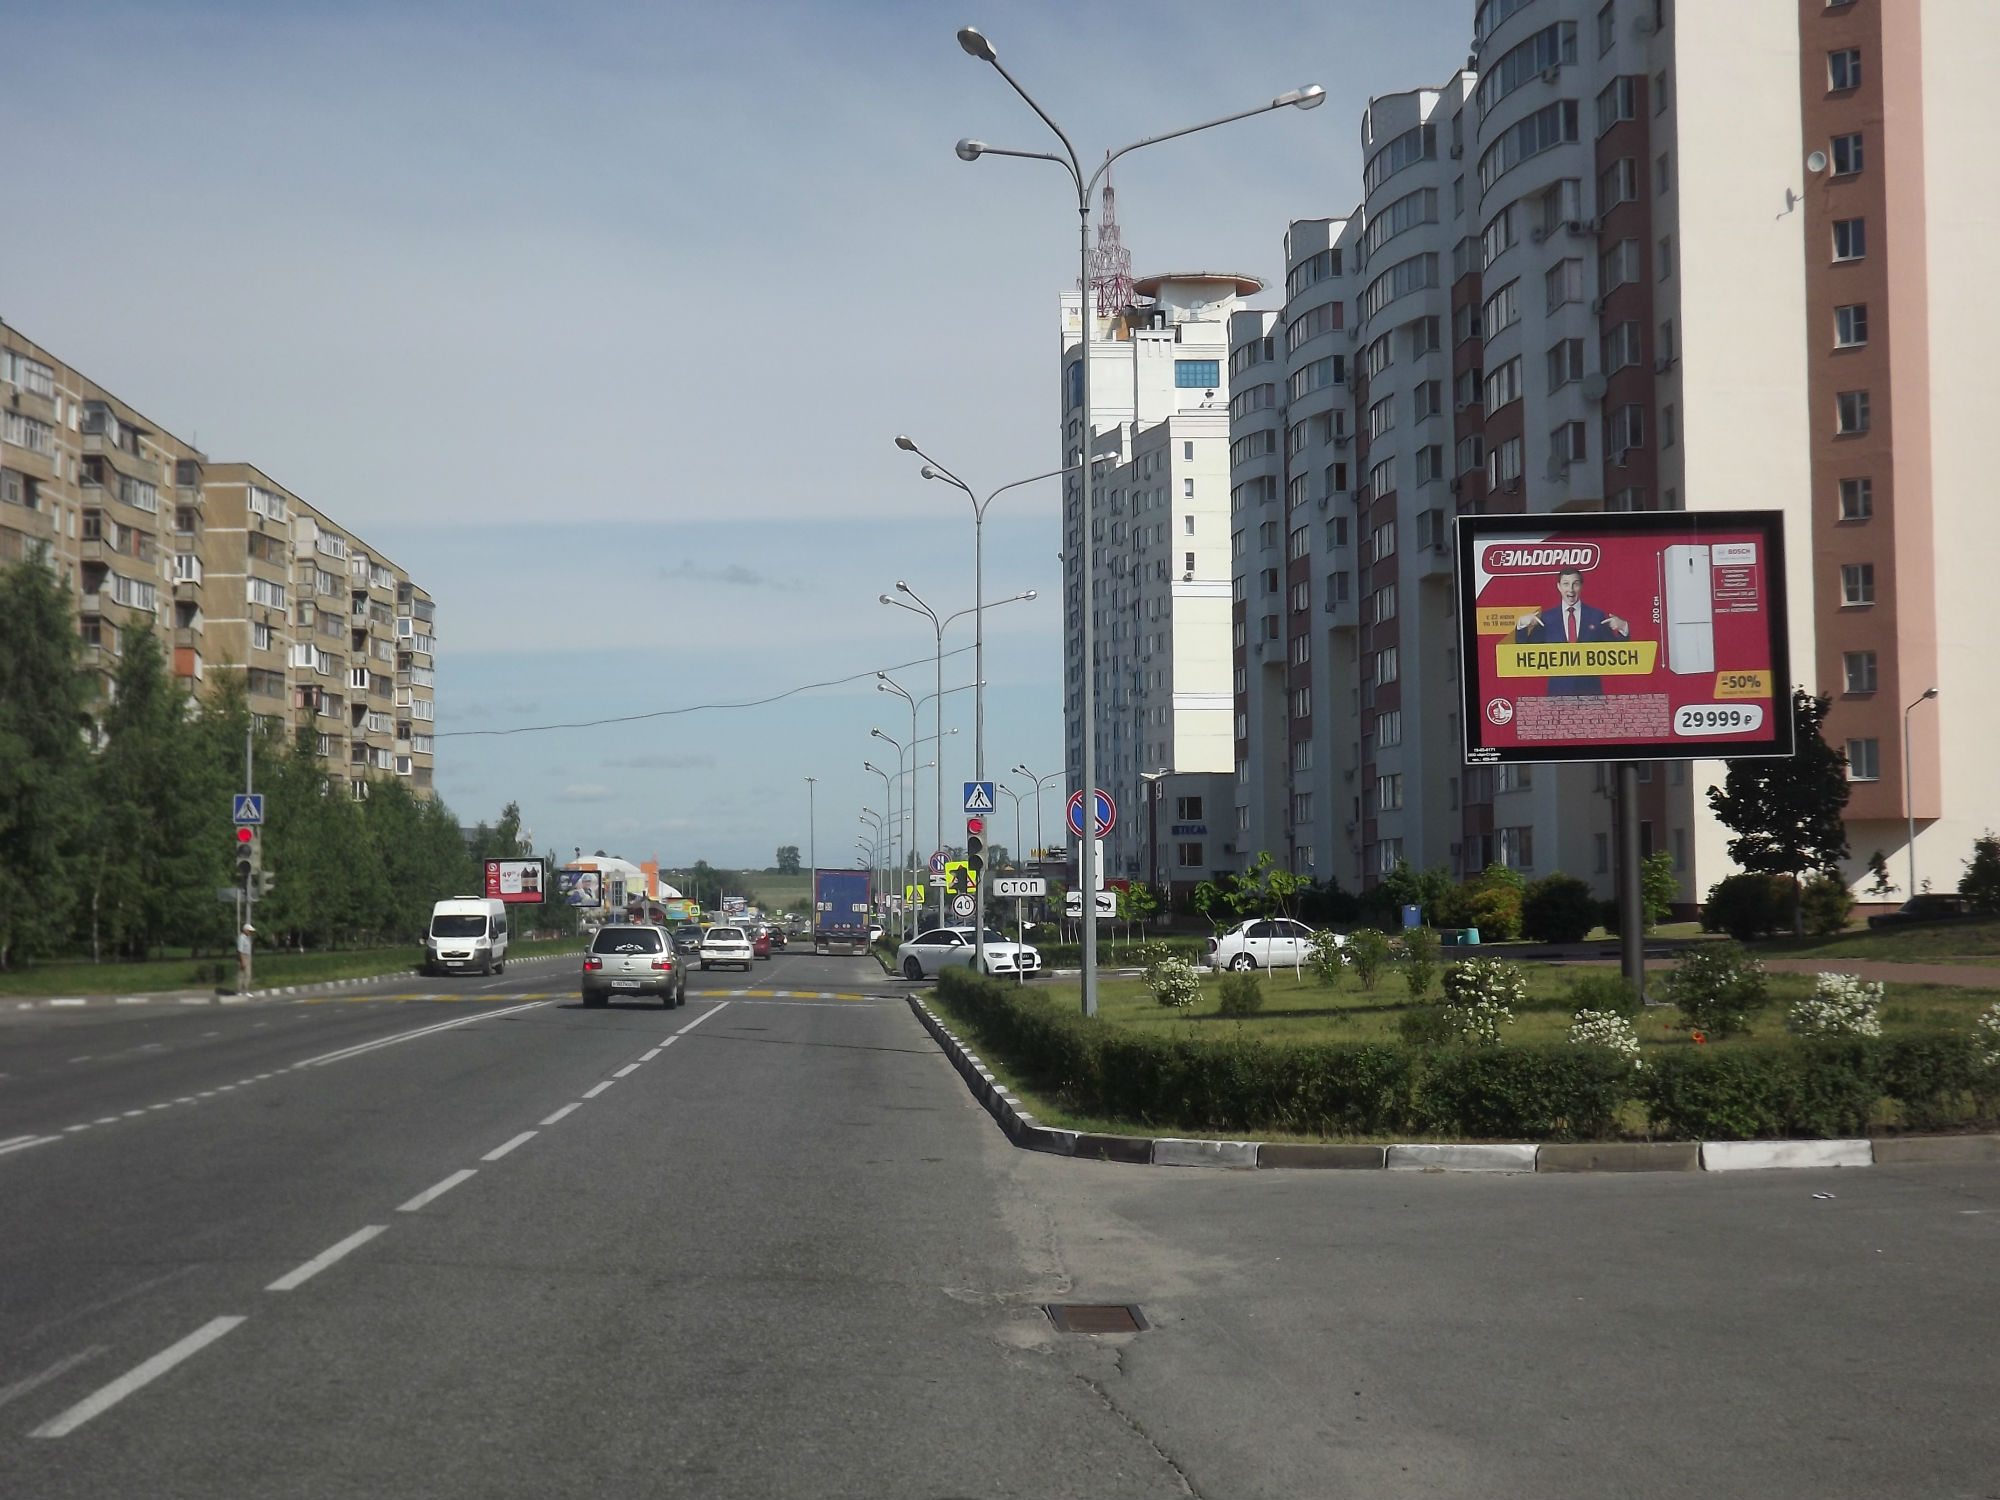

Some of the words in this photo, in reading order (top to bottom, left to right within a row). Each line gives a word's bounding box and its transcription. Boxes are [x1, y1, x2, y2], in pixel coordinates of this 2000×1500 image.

[1652, 608, 1660, 624] 200
[1516, 651, 1581, 670] НЕДЕЛИ
[1586, 650, 1639, 667] BOSCH
[1722, 675, 1761, 689] -50%
[1000, 881, 1038, 893] СТОП
[956, 900, 971, 910] 40
